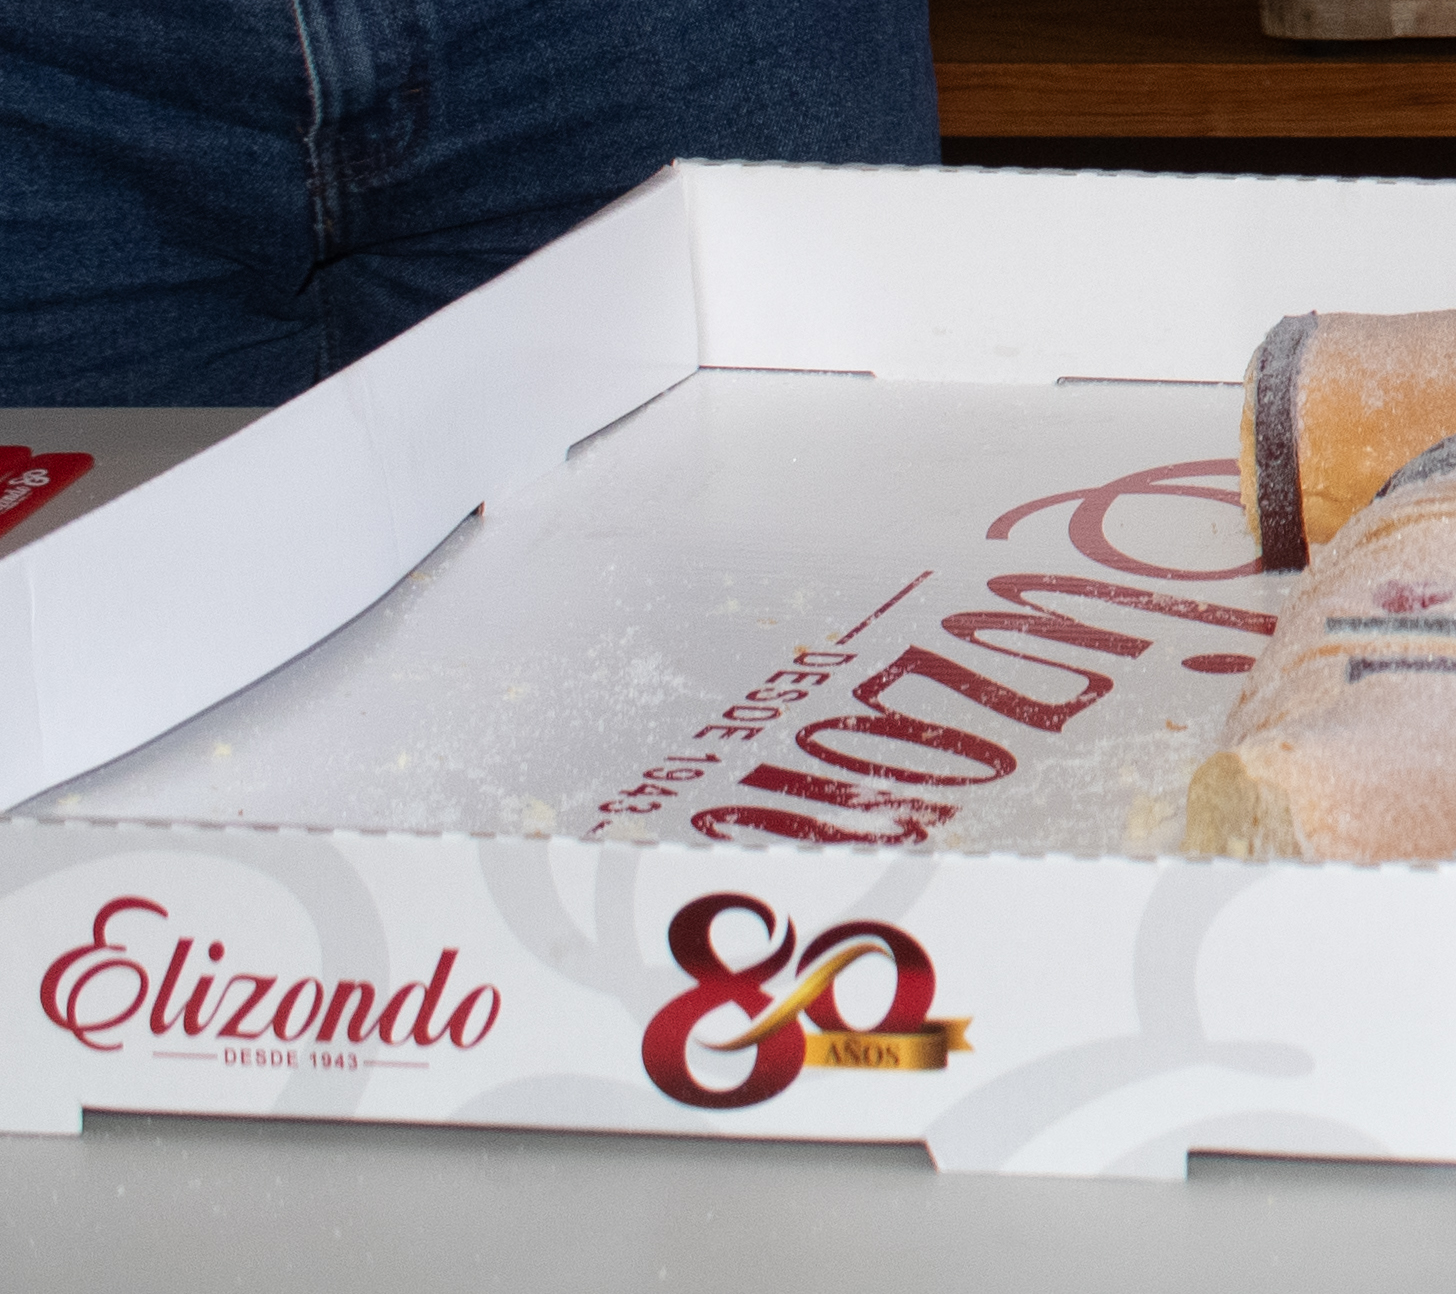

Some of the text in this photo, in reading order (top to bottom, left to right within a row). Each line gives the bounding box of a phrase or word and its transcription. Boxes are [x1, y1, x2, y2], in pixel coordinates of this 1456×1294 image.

[598, 651, 858, 814] DESDE 1943
[40, 894, 502, 1052] Elizondo
[641, 890, 937, 1110] 80
[823, 1037, 901, 1066] AÑOS
[224, 1047, 359, 1072] DESDE 1943
